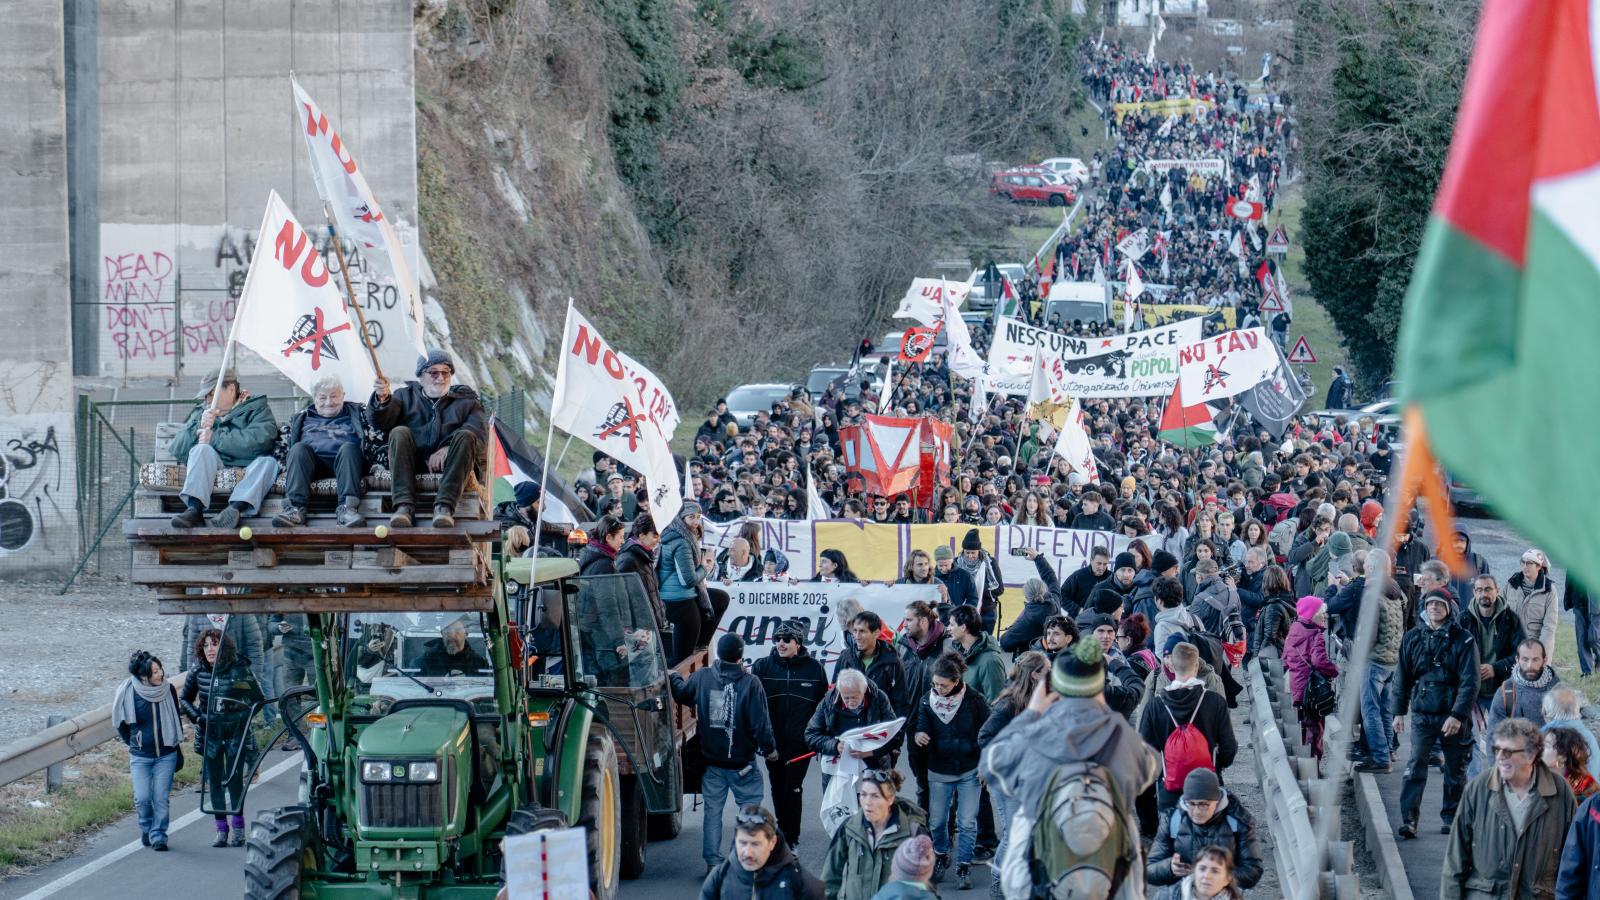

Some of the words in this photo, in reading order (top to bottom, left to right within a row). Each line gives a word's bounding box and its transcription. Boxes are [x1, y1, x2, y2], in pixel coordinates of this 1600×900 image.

[275, 218, 329, 288] NO
[1121, 239, 1134, 251] NO
[104, 251, 173, 283] DEAD
[105, 280, 162, 303] MAN
[106, 303, 175, 331] DON'T
[112, 329, 178, 360] RAPE
[571, 324, 625, 380] NO
[1125, 329, 1178, 350] PACE
[1180, 342, 1206, 367] NO
[1215, 330, 1259, 355] TAV
[1008, 525, 1116, 557] DIFENDI
[739, 592, 746, 605] 8
[749, 592, 799, 605] DICEMBRE
[802, 592, 828, 606] 2025
